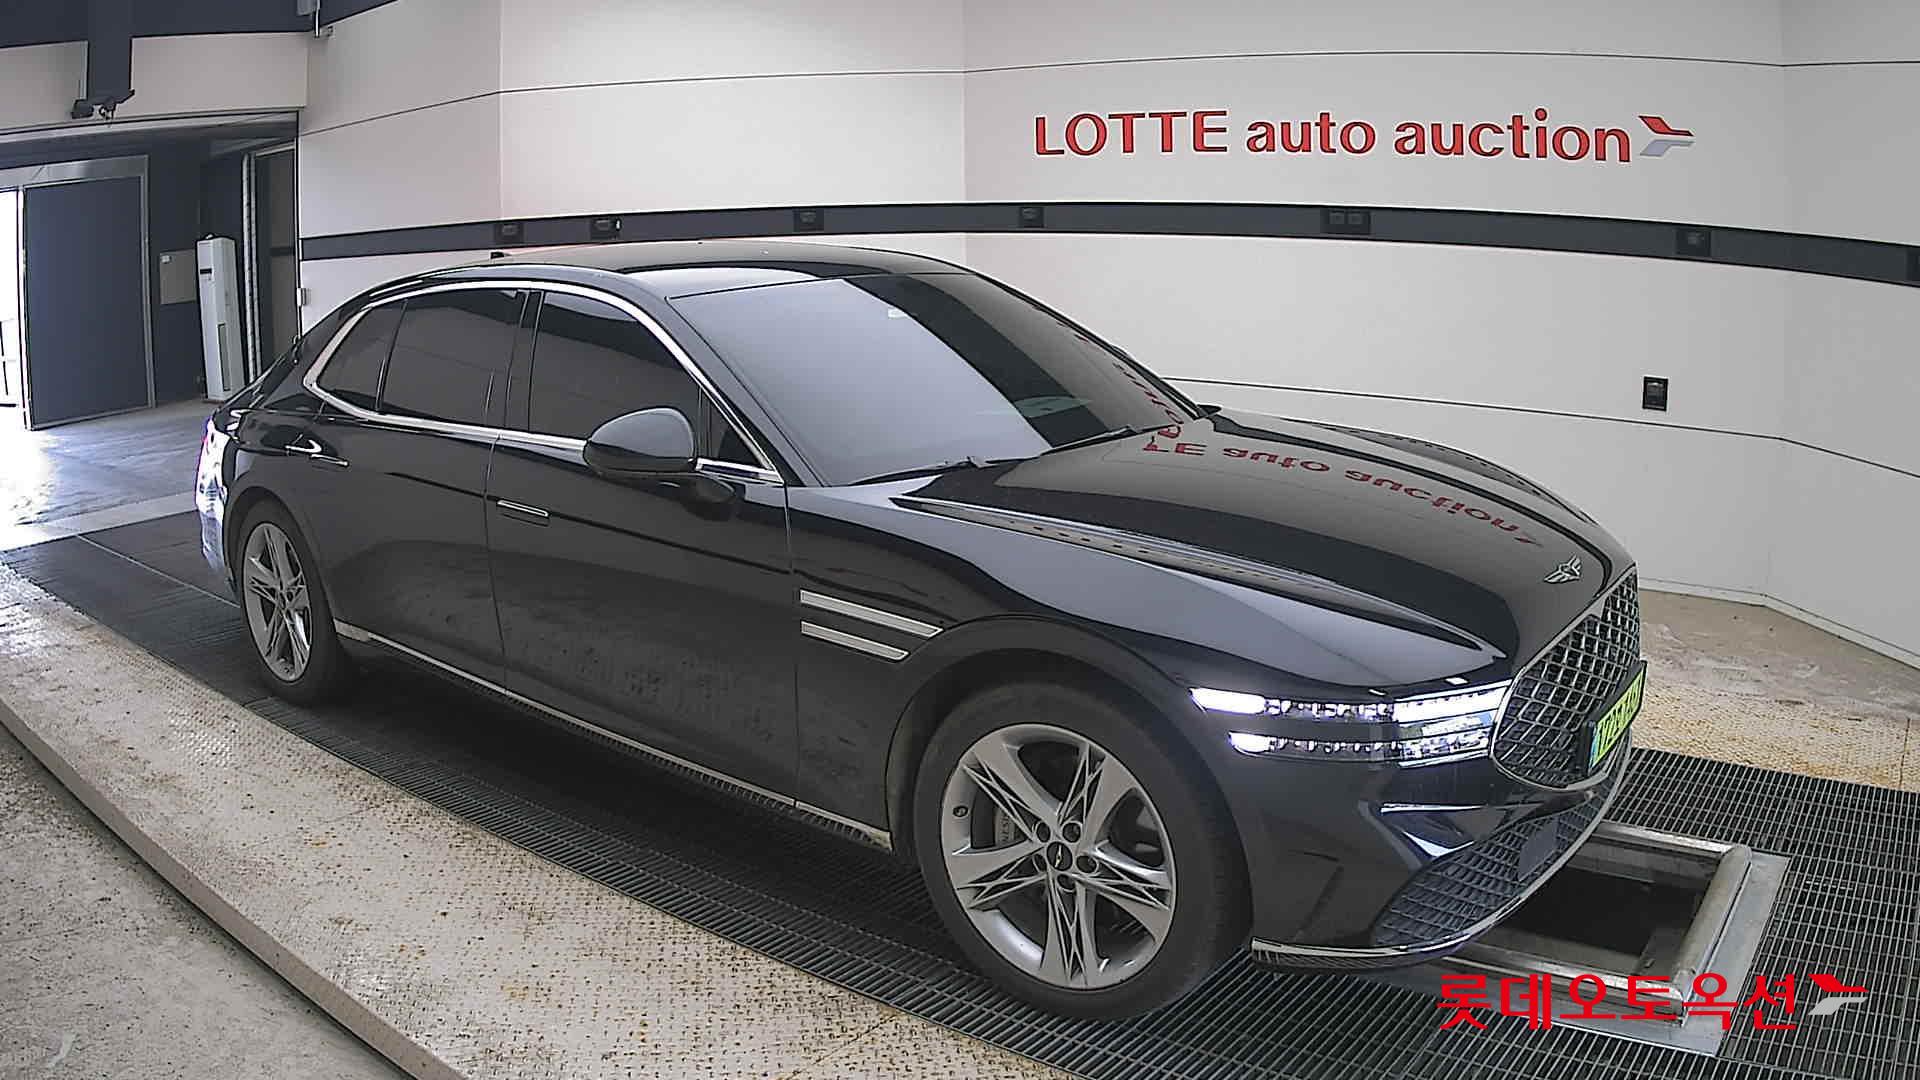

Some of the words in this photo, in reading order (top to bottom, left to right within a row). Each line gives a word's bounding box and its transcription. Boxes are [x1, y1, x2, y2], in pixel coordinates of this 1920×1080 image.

[1035, 109, 1228, 156] LOTTE
[1246, 111, 1376, 156] auto
[1394, 107, 1631, 164] auction
